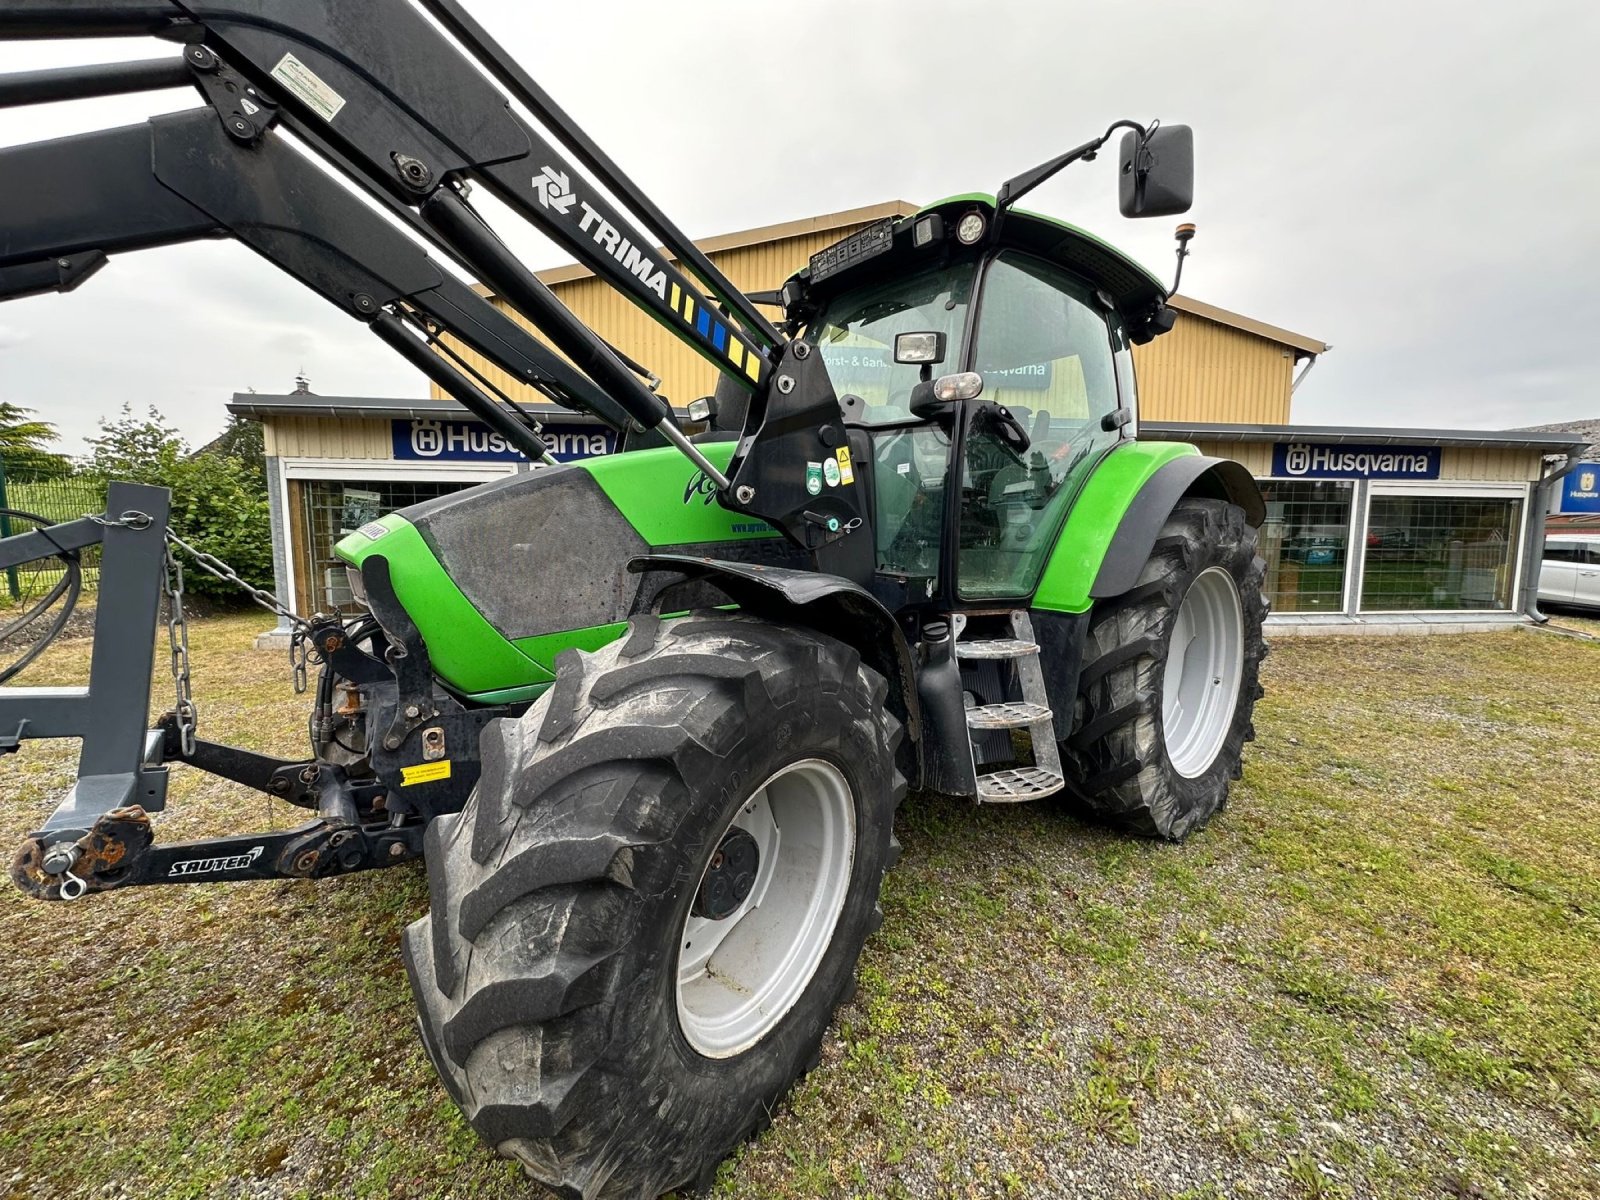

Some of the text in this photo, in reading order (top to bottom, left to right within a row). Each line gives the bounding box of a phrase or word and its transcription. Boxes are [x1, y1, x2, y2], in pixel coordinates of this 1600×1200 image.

[578, 201, 667, 300] TRIMA
[851, 356, 859, 367] &
[447, 425, 607, 458] Husarna
[1312, 448, 1428, 476] Husqvarna
[168, 855, 252, 876] SAUTER
